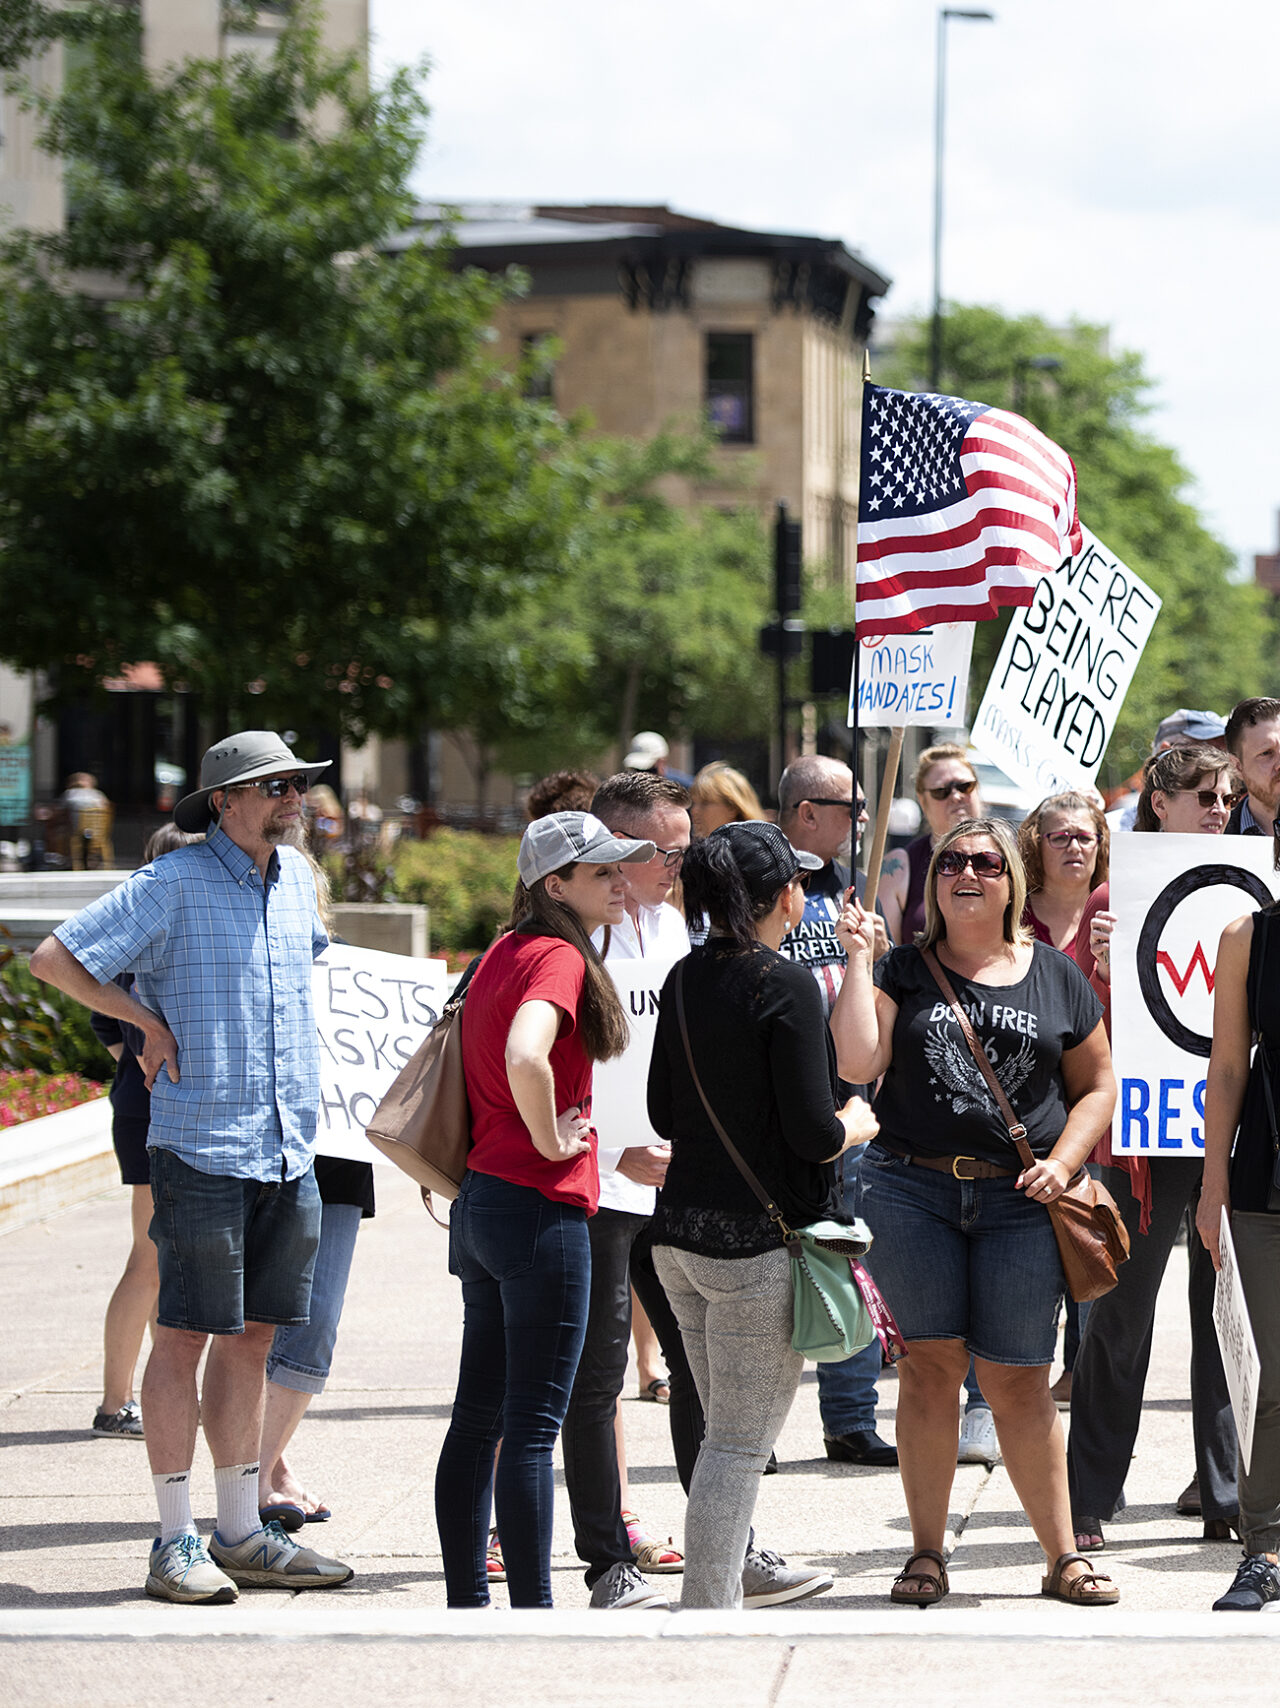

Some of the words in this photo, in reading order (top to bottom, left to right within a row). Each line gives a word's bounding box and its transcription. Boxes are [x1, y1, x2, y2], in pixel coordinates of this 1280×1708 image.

[870, 644, 935, 679] MASK
[1023, 576, 1126, 701] BEING
[1000, 633, 1106, 769] PLAYED
[991, 1004, 1039, 1040] FREE
